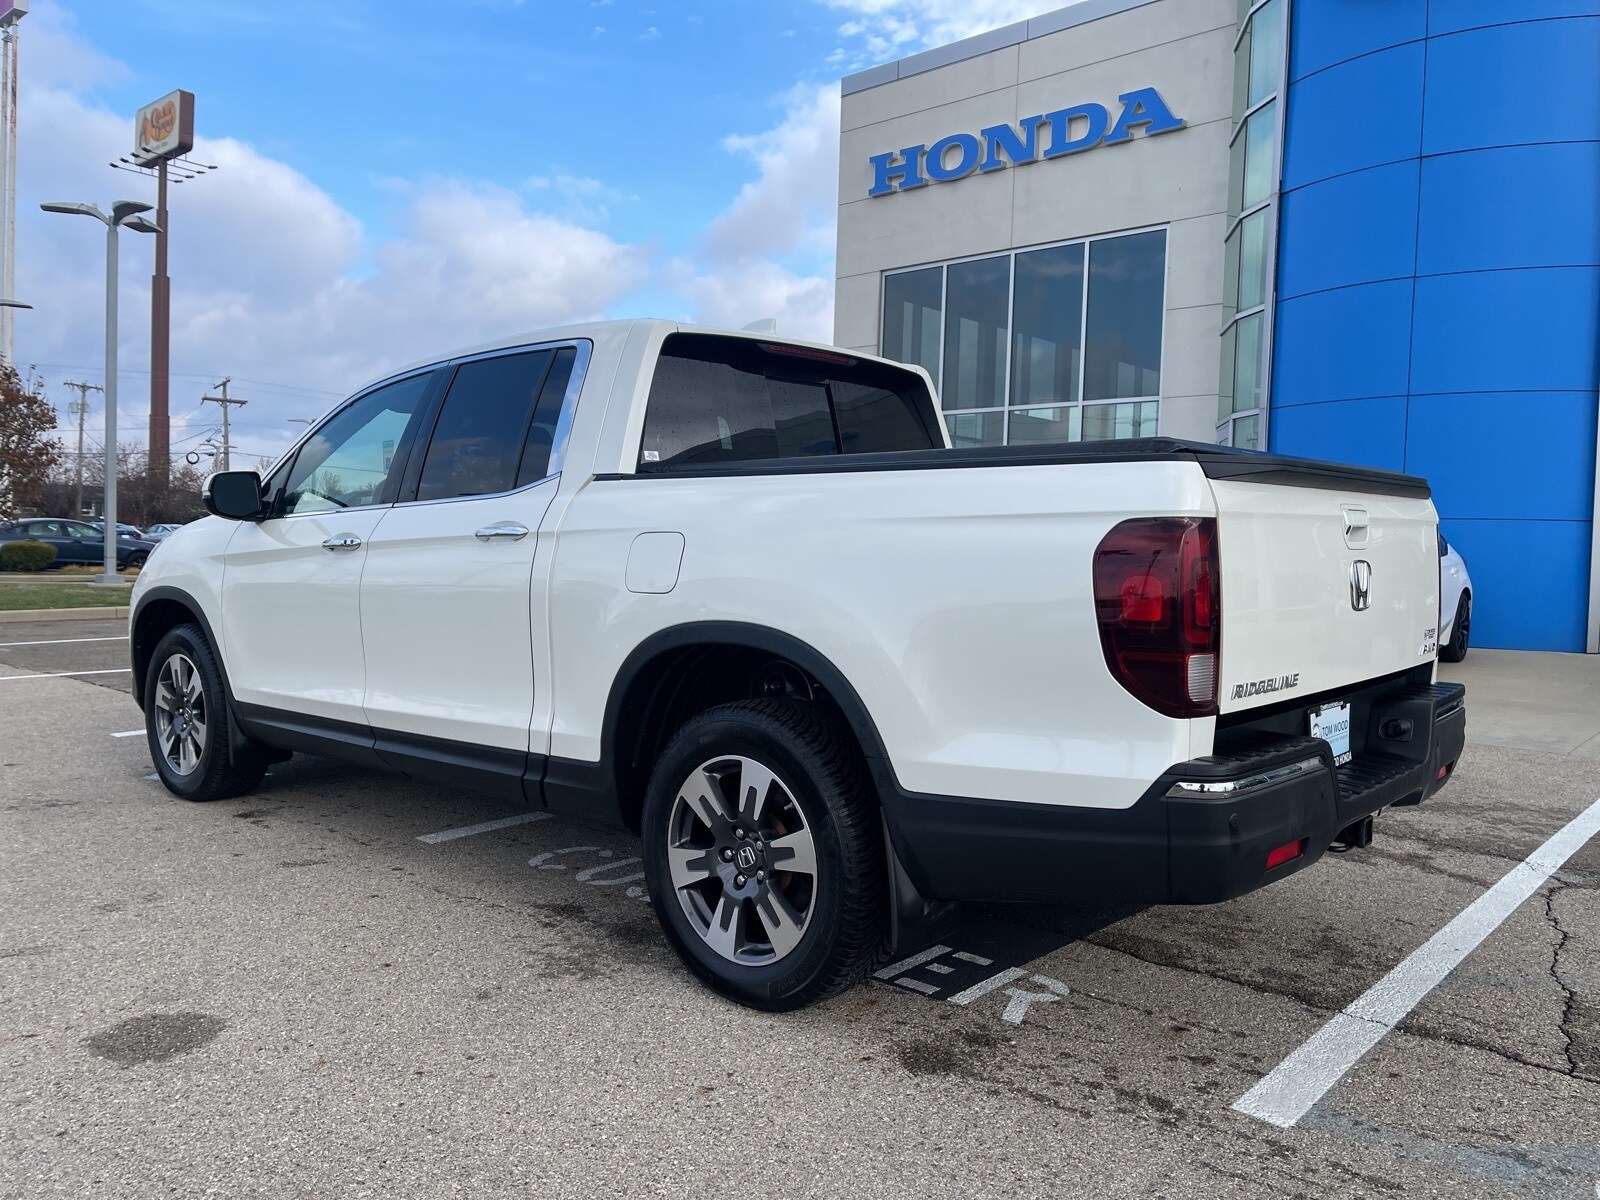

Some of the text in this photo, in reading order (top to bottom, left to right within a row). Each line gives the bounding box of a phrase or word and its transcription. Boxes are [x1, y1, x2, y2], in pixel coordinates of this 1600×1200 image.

[868, 86, 1187, 198] HONDA
[1231, 673, 1299, 700] RIDGELINE
[1322, 724, 1333, 738] TOM
[1333, 719, 1349, 733] WOOD
